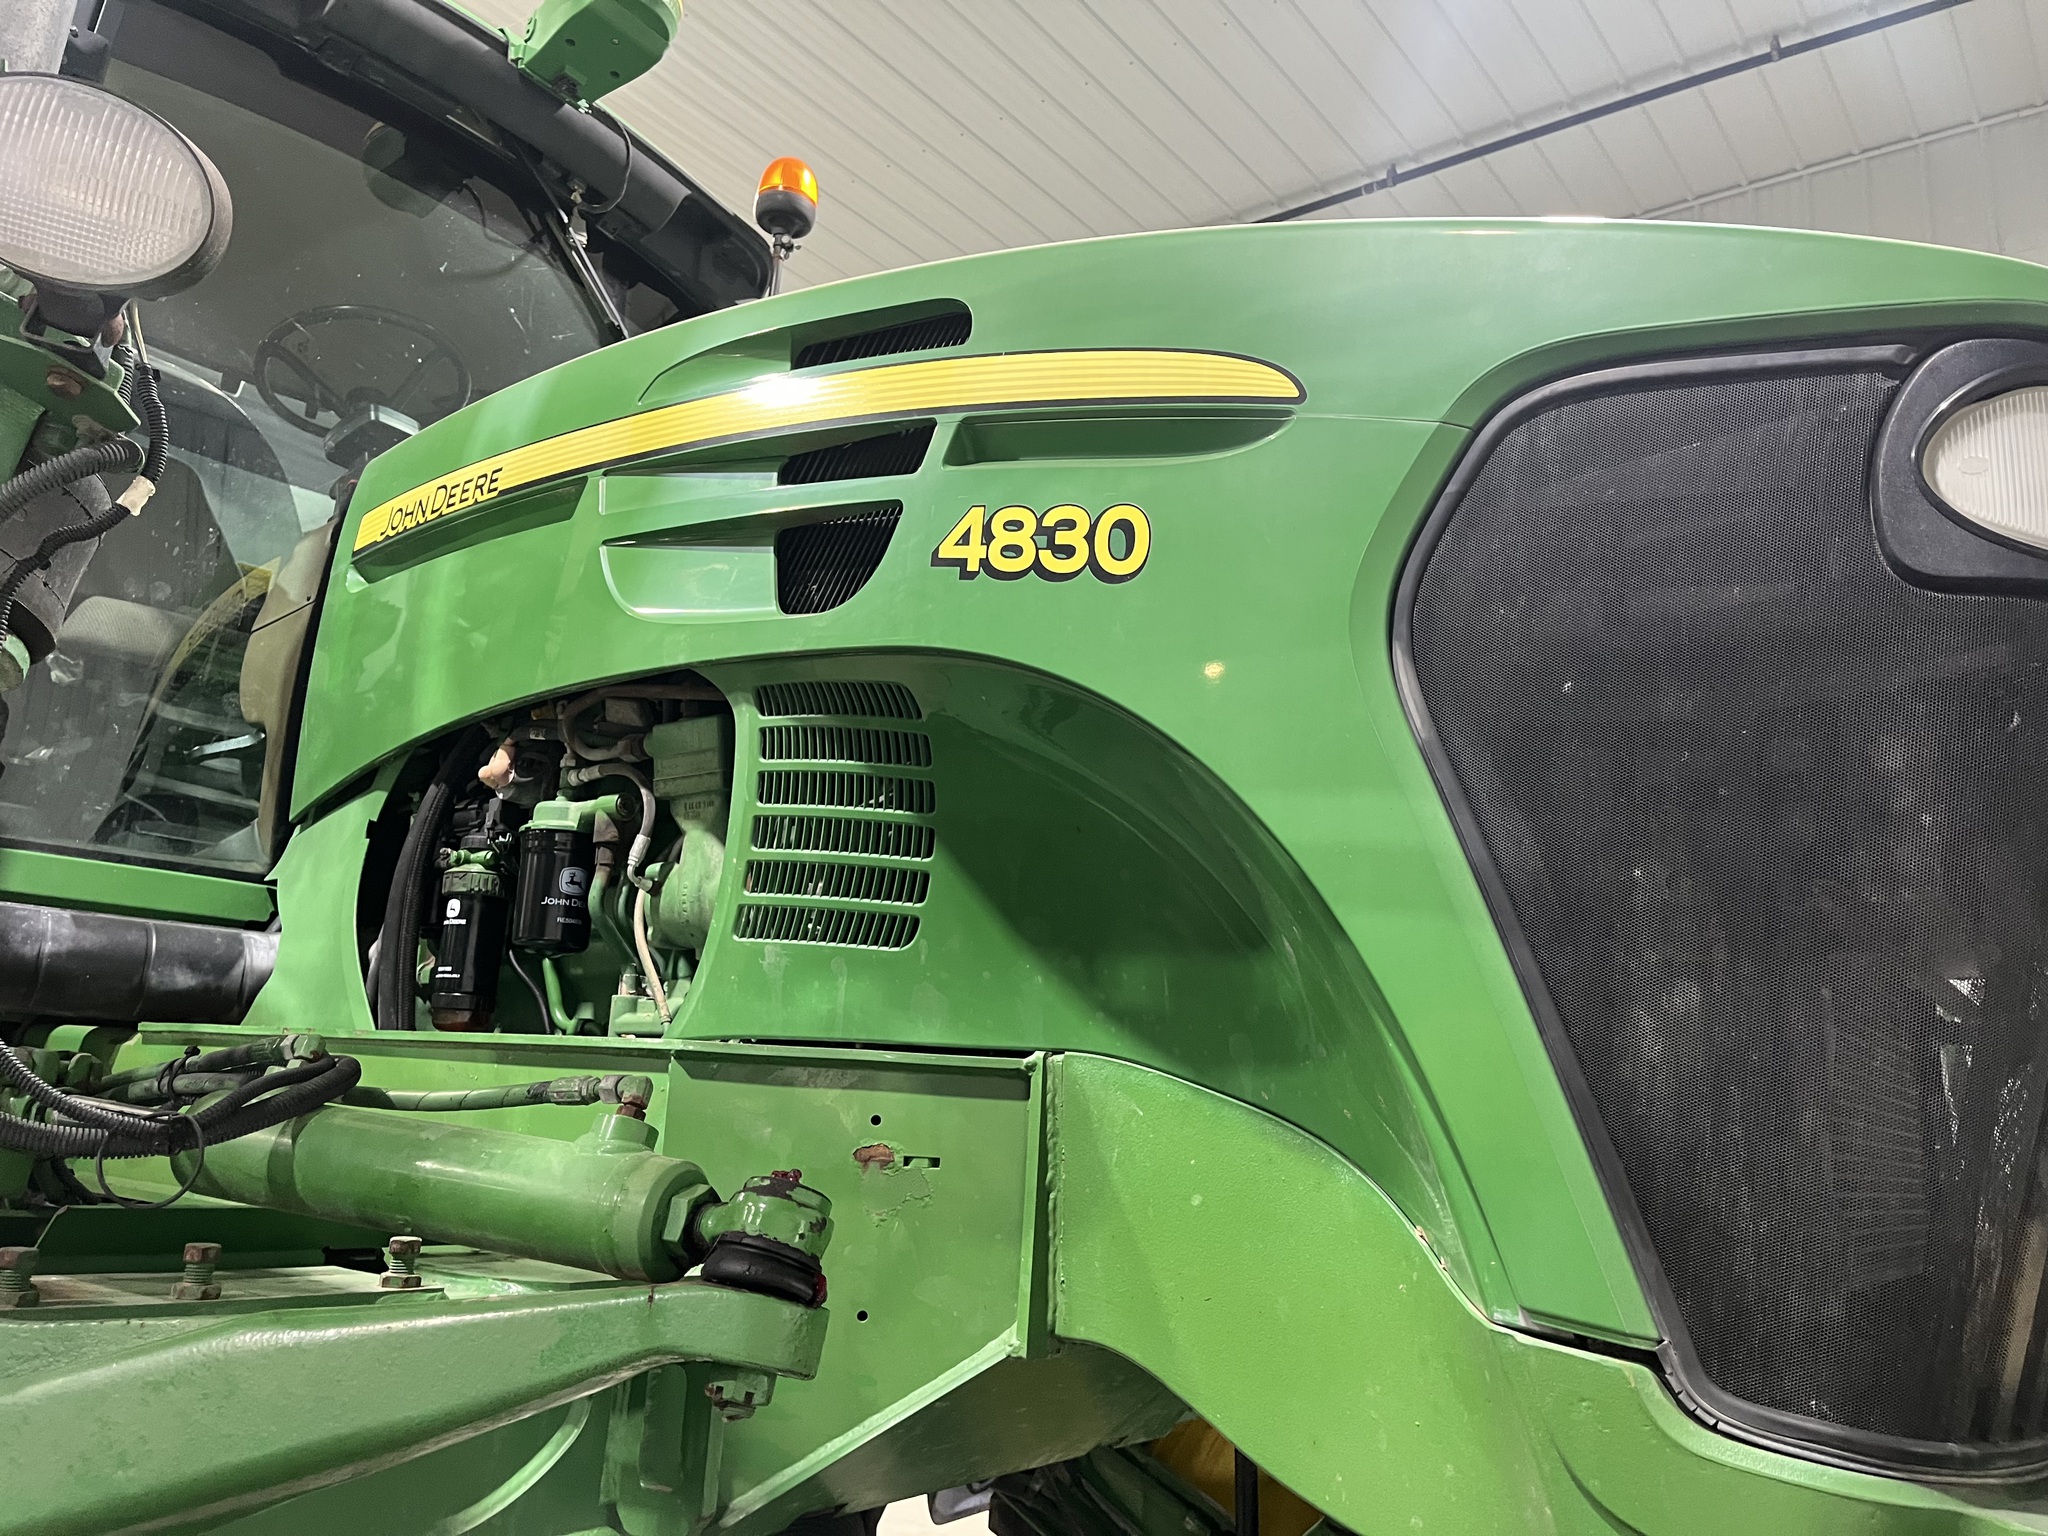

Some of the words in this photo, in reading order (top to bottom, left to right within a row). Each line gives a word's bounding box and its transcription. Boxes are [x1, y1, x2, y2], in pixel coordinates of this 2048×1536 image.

[380, 495, 430, 537] JOHN
[431, 467, 503, 514] DEERE
[931, 503, 1152, 584] 4830
[541, 896, 570, 906] JOHN
